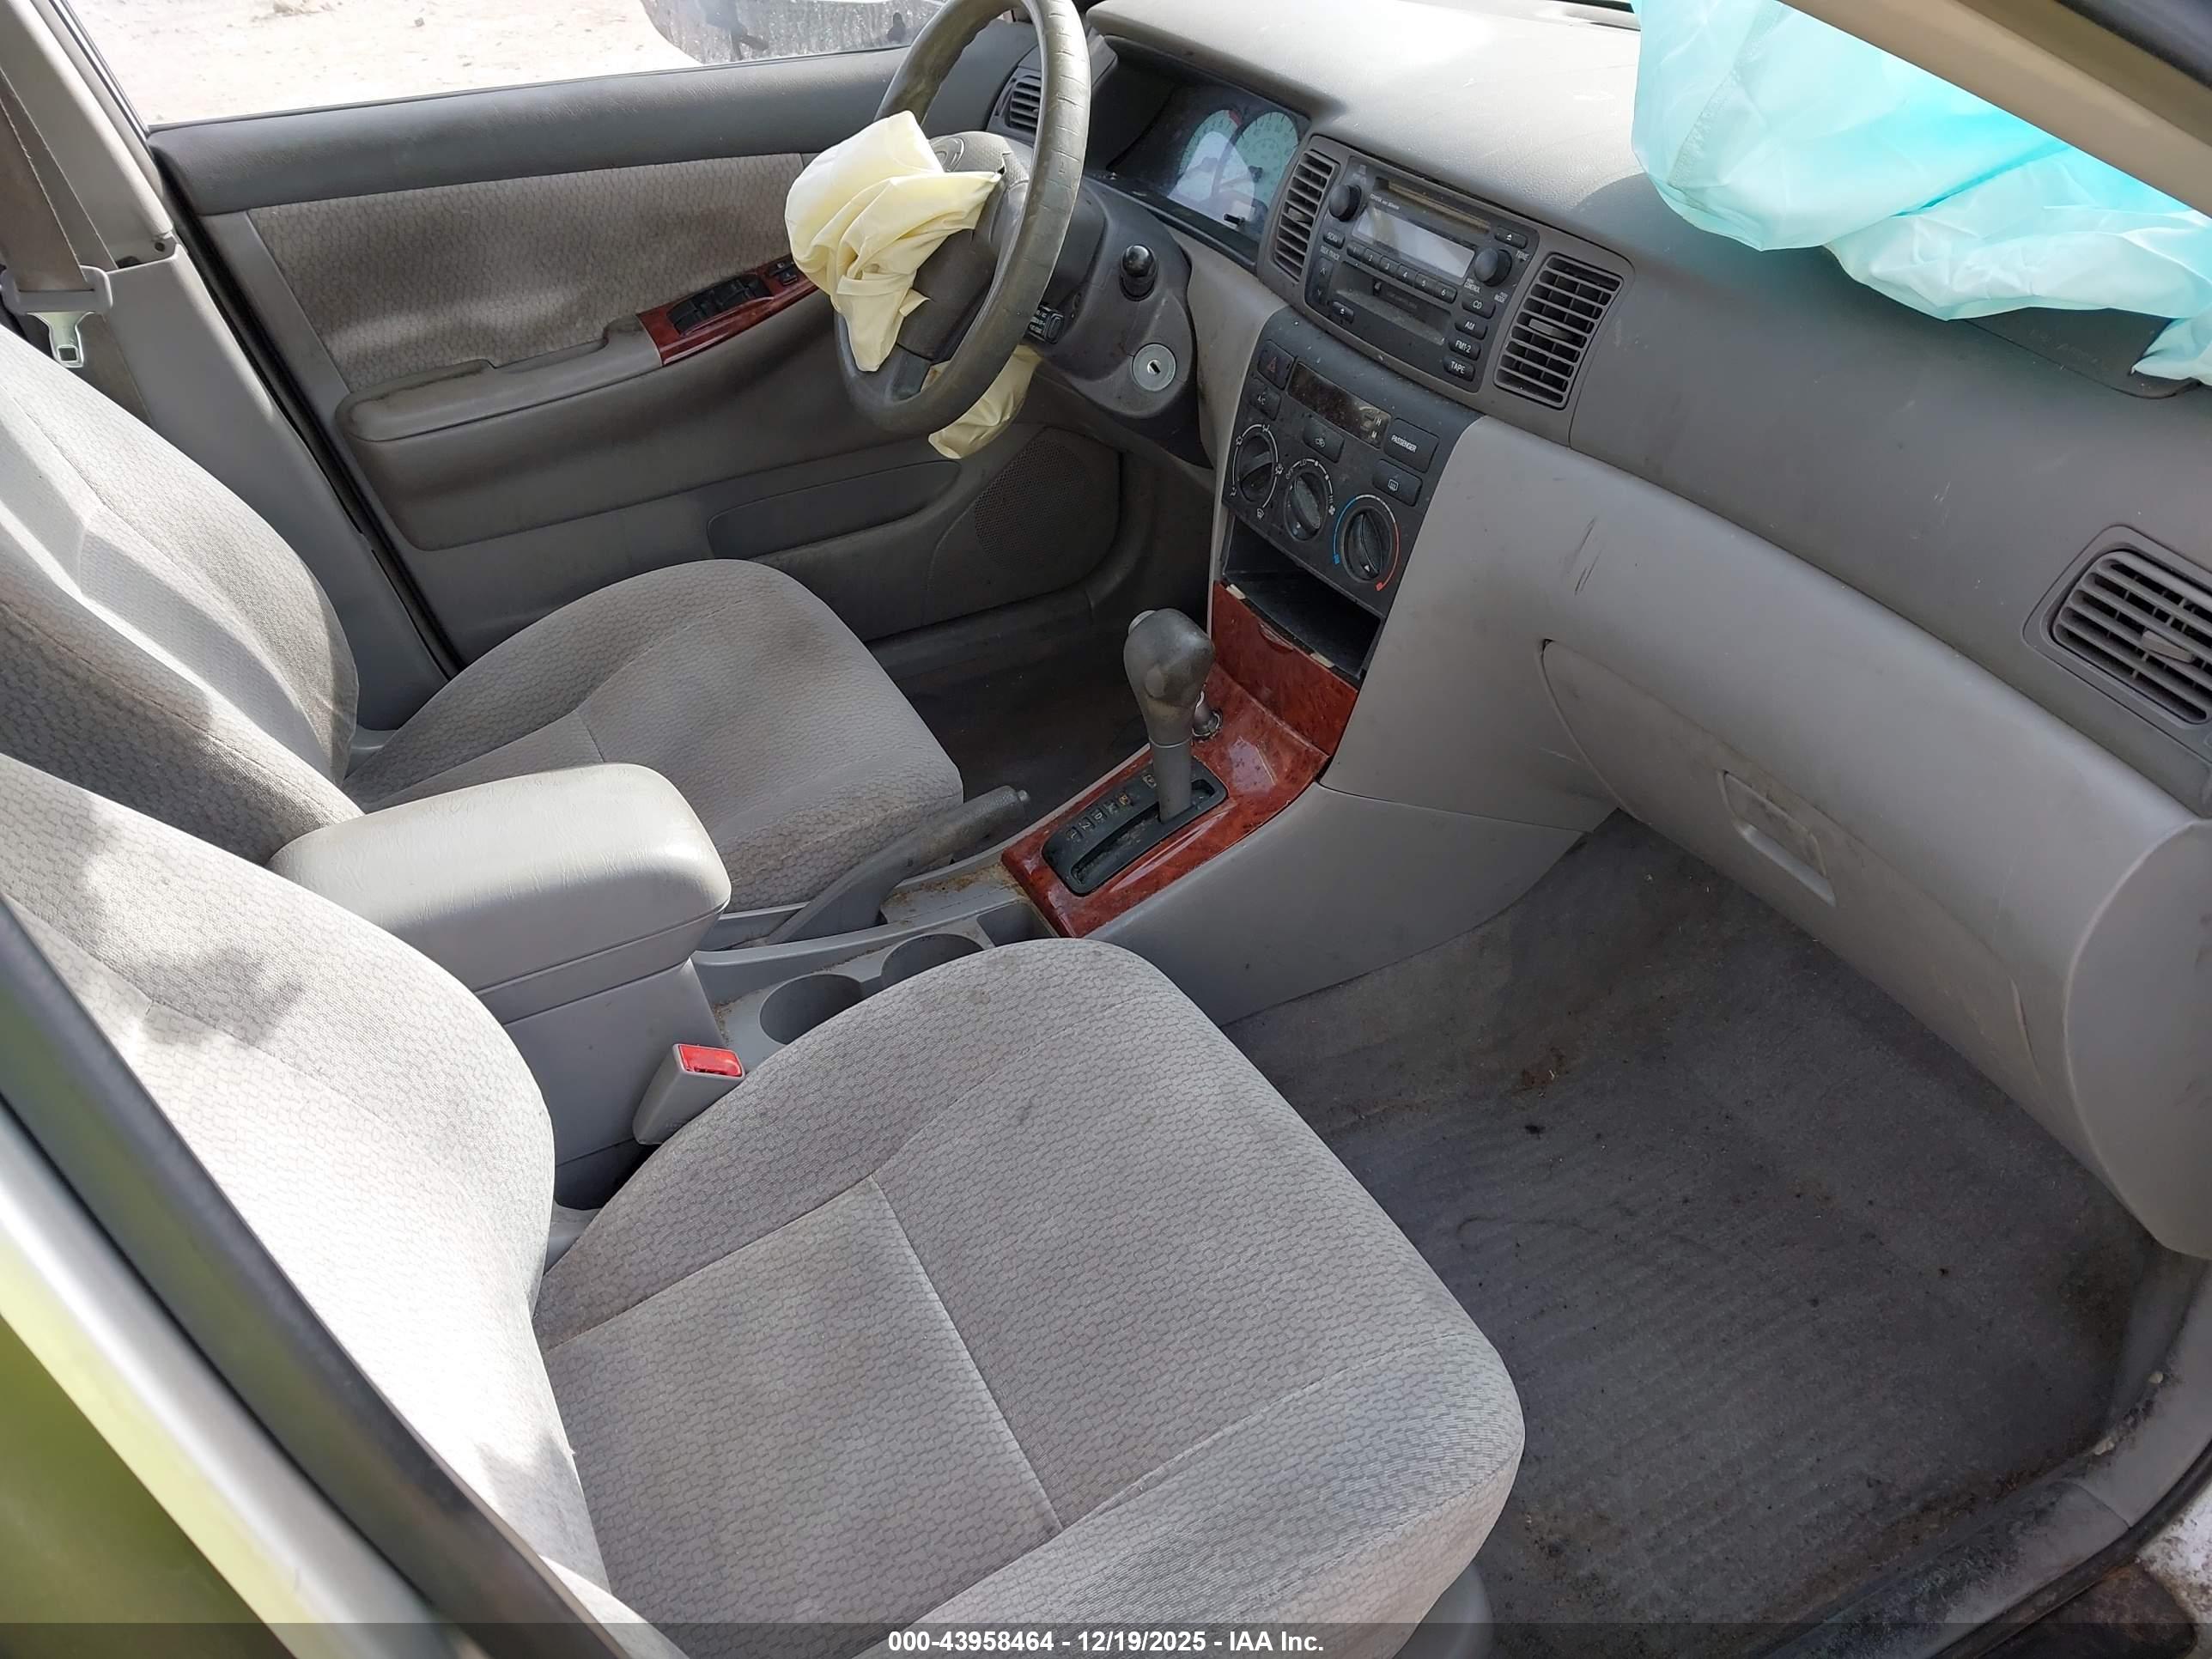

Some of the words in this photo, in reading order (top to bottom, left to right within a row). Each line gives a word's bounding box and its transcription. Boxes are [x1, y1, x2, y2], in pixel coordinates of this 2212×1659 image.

[1473, 300, 1483, 309] CD
[1464, 321, 1475, 331] AM
[1450, 361, 1466, 374] TAPE
[1376, 417, 1382, 427] H
[1391, 434, 1418, 453] PASSENGER
